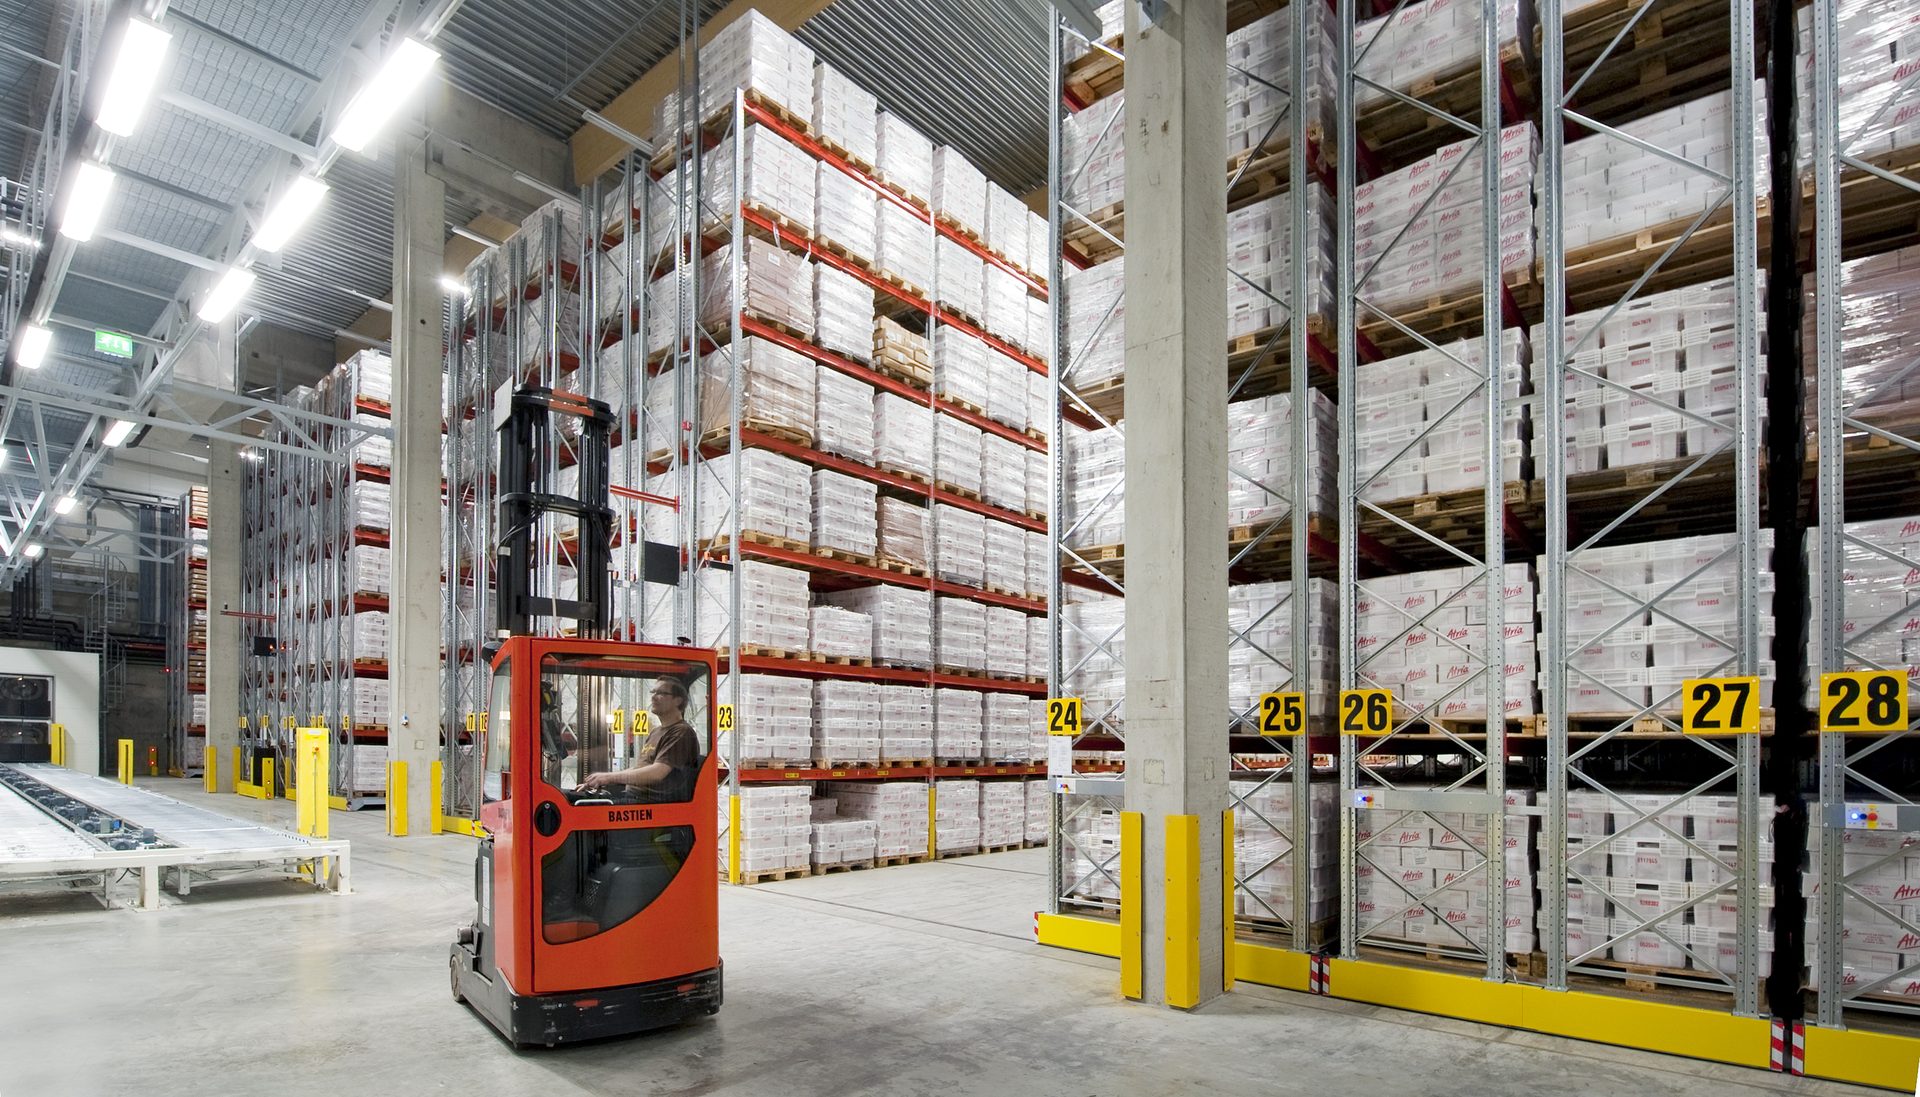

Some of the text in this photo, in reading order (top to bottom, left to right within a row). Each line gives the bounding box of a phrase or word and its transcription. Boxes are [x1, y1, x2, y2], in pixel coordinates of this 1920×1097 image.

[1501, 126, 1524, 142] Atria
[1440, 144, 1463, 163] Atria
[1501, 147, 1524, 162] Atria
[1409, 162, 1430, 179] Atria
[1356, 184, 1374, 201] Atria
[1408, 180, 1431, 198] Atria
[1501, 190, 1524, 207] Atria
[1356, 202, 1374, 220] Atria
[1440, 208, 1461, 226] Atria
[1441, 229, 1462, 247] Atria
[1501, 231, 1524, 248] Atria
[1408, 240, 1429, 256] Atria
[1440, 250, 1462, 267] Atria
[1502, 249, 1526, 267] Atria
[1408, 260, 1428, 275] Atria
[1441, 267, 1462, 284] Atria
[1409, 277, 1430, 294] Atria
[1404, 594, 1425, 609] Atria
[1406, 632, 1428, 647] Atria
[1446, 625, 1468, 640] Atria
[1358, 635, 1377, 649] Atria
[1405, 668, 1427, 682] Atria
[1447, 664, 1469, 680] Atria
[1445, 699, 1467, 715] Atria
[1692, 683, 1750, 729] 27
[1827, 676, 1900, 726] 28
[719, 707, 732, 728] 23
[1050, 702, 1077, 731] 24
[1264, 696, 1301, 731] 25
[1344, 693, 1388, 731] 26
[613, 712, 622, 731] 21
[635, 713, 647, 733] 22
[608, 809, 653, 822] BASTIEN
[1358, 831, 1371, 841] tria
[1400, 831, 1420, 845] Atria
[1402, 870, 1423, 882] Atria
[1446, 911, 1466, 924] Atria
